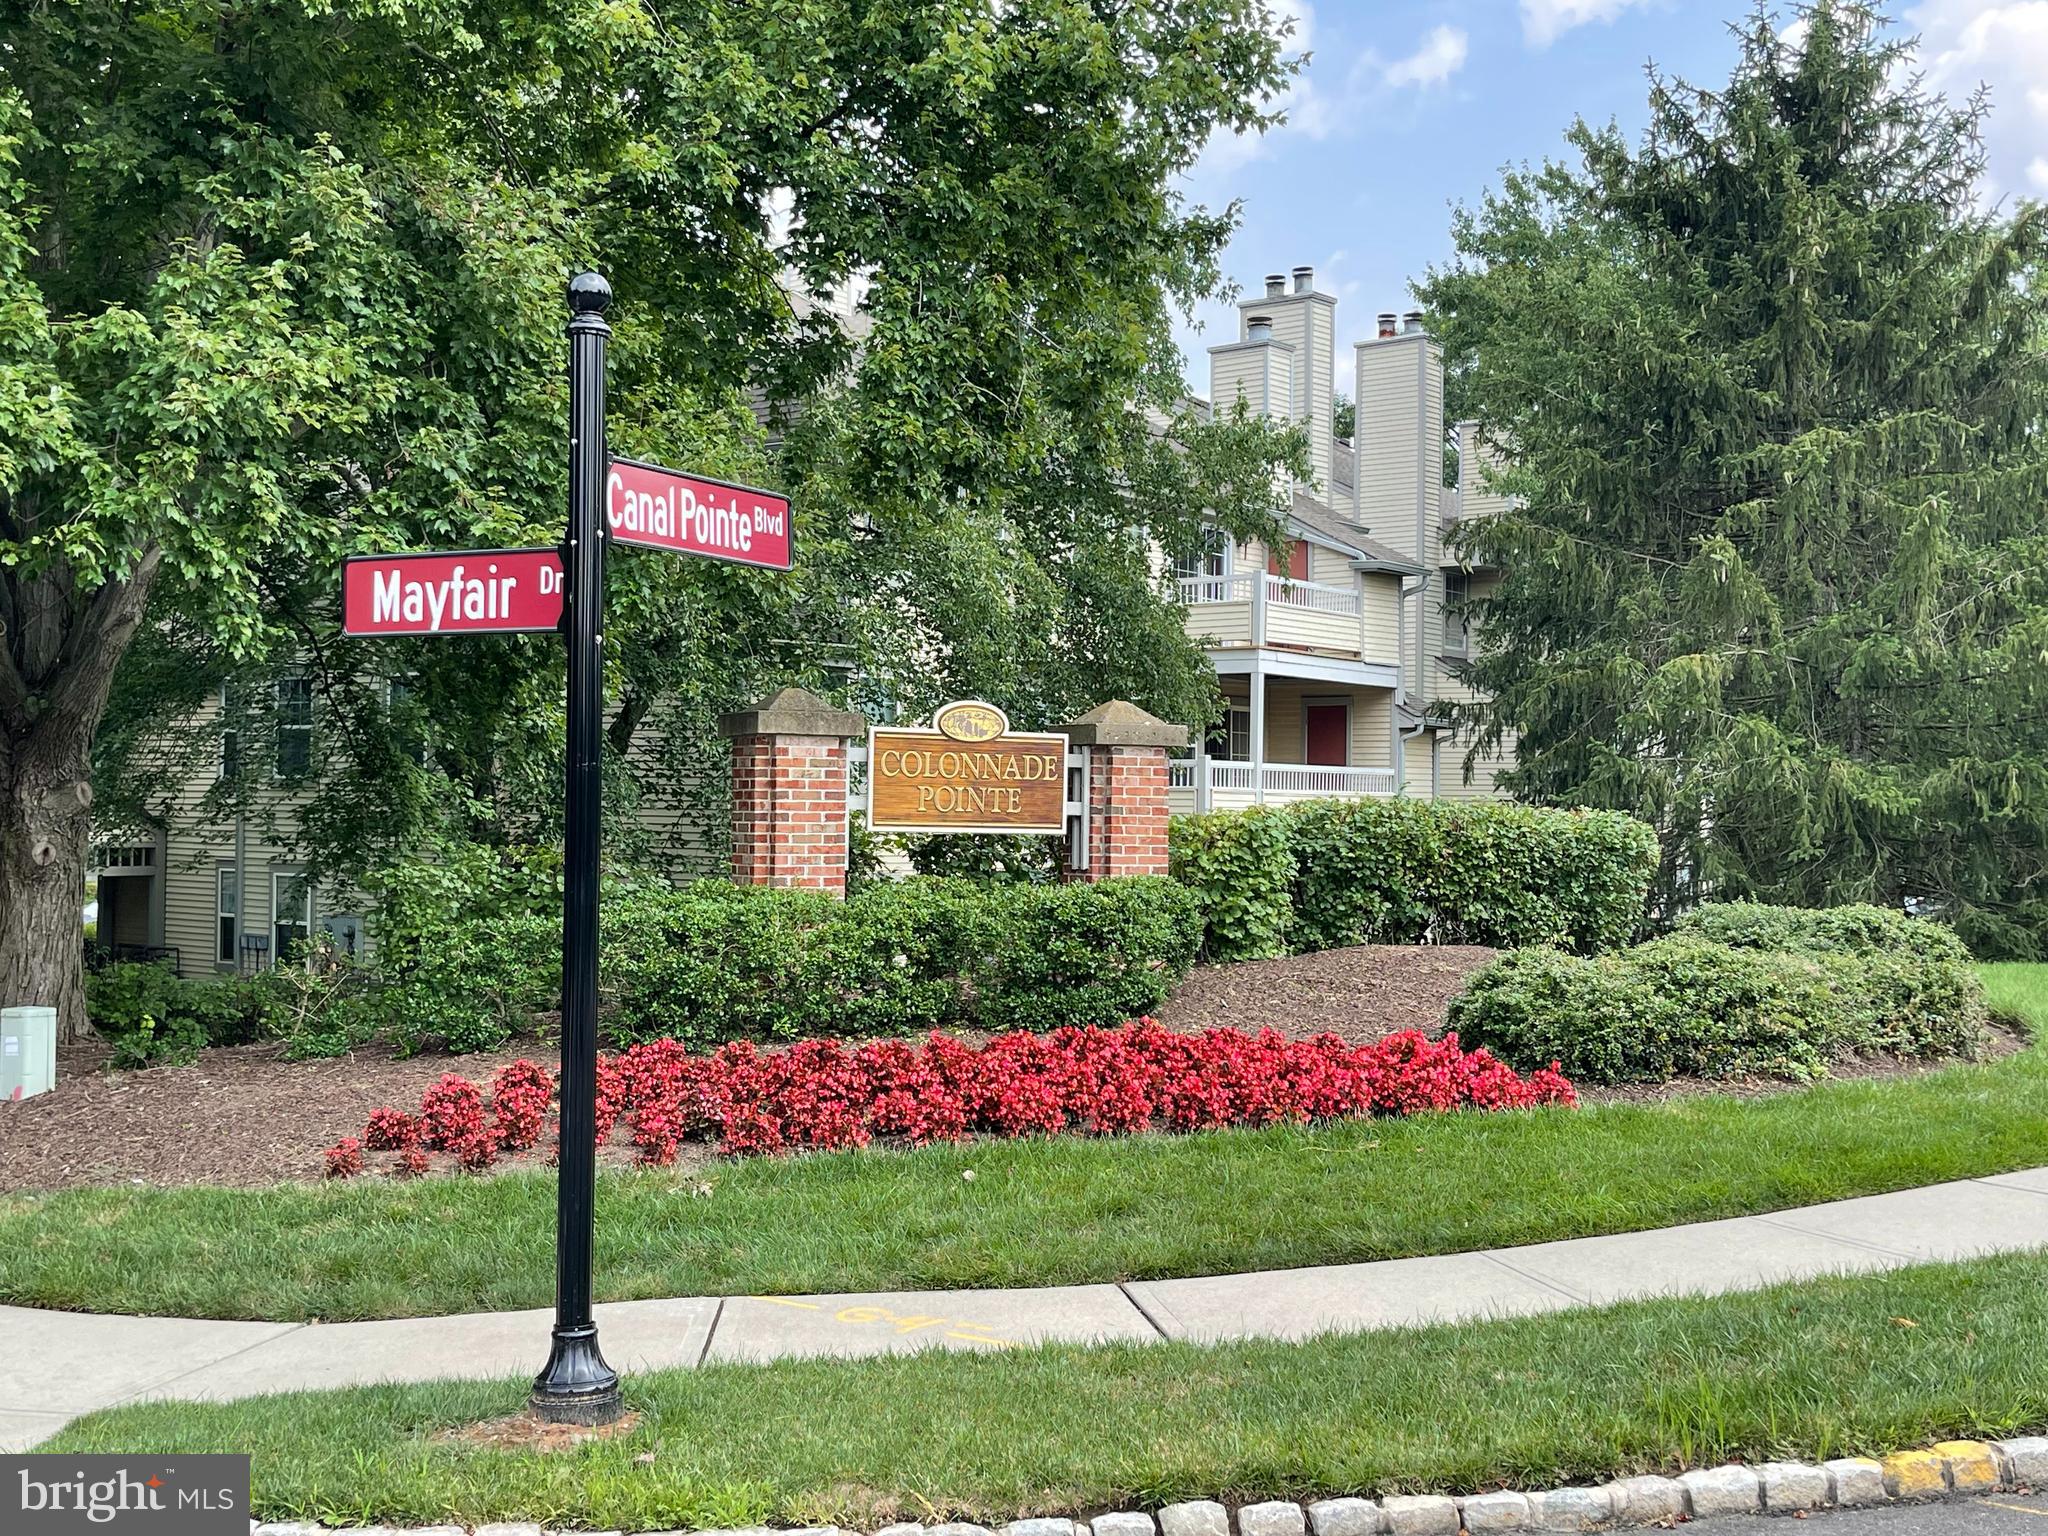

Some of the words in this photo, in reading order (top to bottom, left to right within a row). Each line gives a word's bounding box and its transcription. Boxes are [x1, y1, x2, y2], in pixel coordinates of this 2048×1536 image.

[606, 472, 675, 538] Canal
[681, 488, 752, 553] Pointe
[753, 505, 784, 537] Blvd
[372, 565, 517, 632] Mayfair
[539, 565, 564, 596] Dr
[880, 750, 1058, 781] COLONNADE
[917, 785, 1022, 814] POINTE
